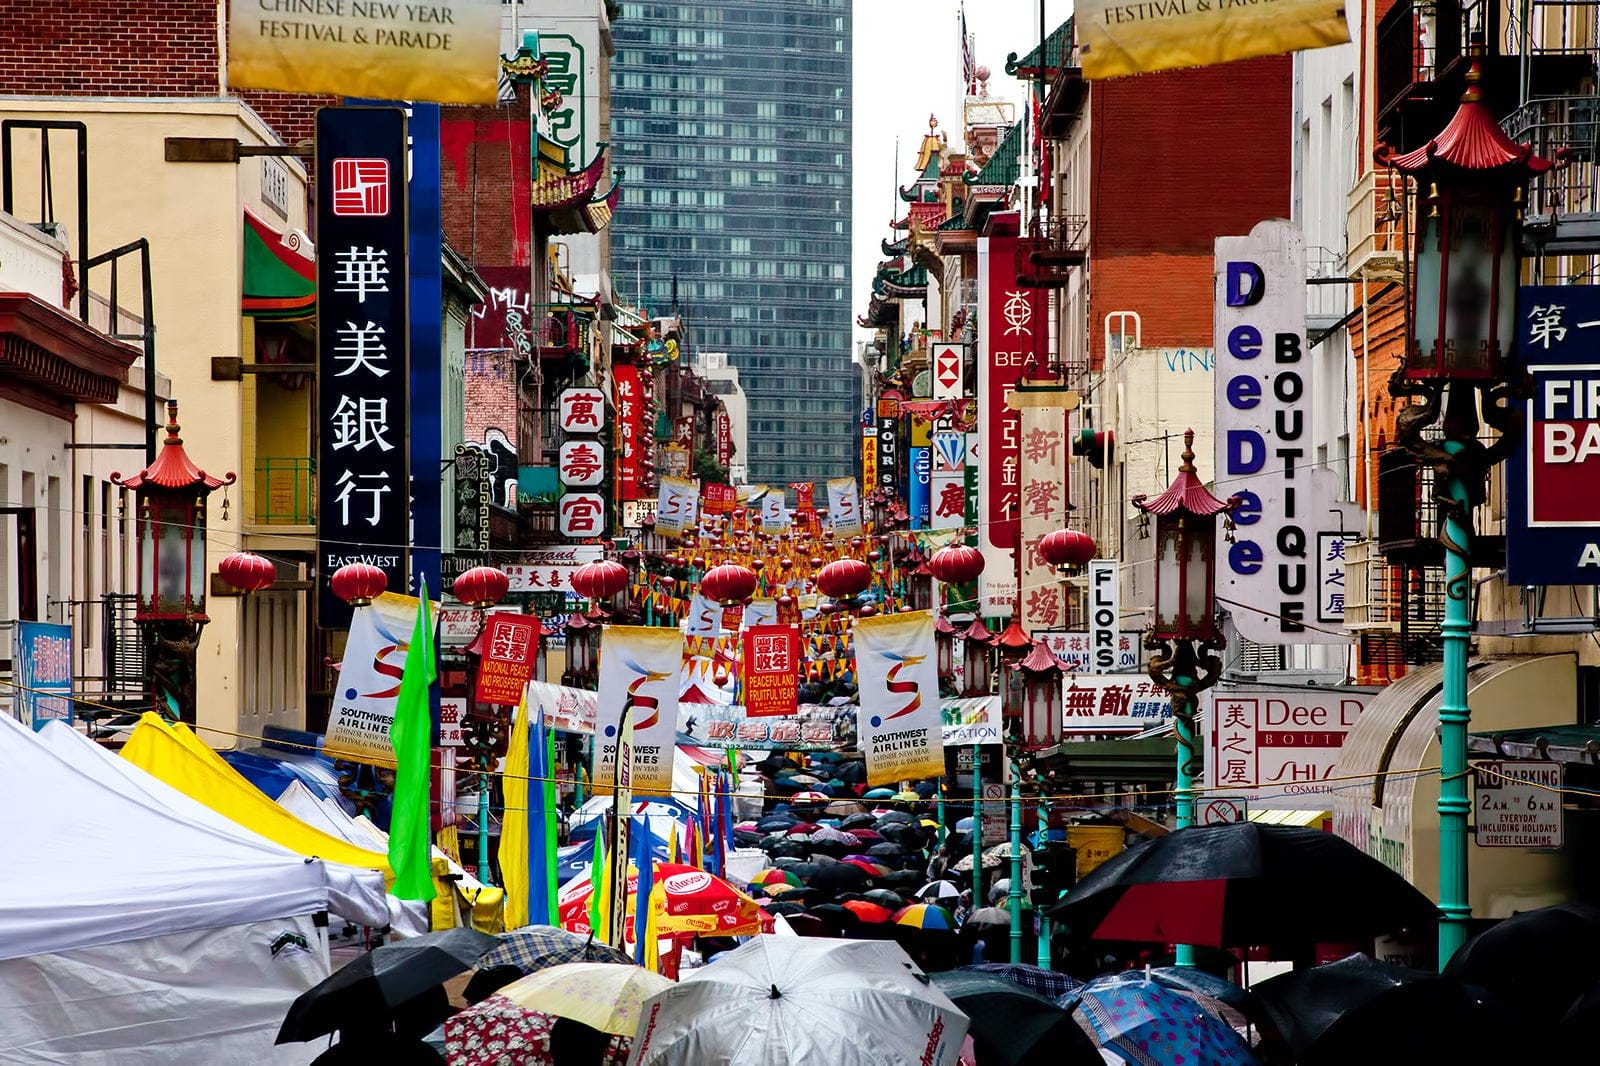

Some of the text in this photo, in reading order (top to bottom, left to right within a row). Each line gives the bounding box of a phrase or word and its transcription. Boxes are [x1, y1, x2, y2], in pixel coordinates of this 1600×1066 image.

[260, 0, 454, 24] CHINESE NEW YEAR
[1105, 0, 1192, 24] FESTIVAL
[260, 20, 452, 50] FESTIVAL & PARADE
[995, 351, 1038, 367] BEA
[331, 247, 395, 526] 華美銀行
[882, 419, 894, 465] FOUR
[562, 393, 603, 532] 萬壽宮
[1273, 333, 1306, 633] BOUTIQUE
[482, 660, 529, 677] NATIONAL PEACE
[480, 674, 525, 690] AND PROSPERIT
[749, 674, 794, 688] PEACEFUL AND
[749, 687, 795, 701] FRUITFUL YEAR
[1066, 684, 1133, 717] 無敵
[340, 707, 394, 725] SOUTHWES
[1265, 699, 1327, 726] Dee
[338, 717, 388, 734] AIRLINE
[942, 727, 997, 740] STATION
[872, 728, 928, 744] SOUTHWEST
[1221, 704, 1252, 784] 美之屋
[873, 738, 927, 753] AIRLINES
[1478, 765, 1558, 786] NO PARKING
[1482, 794, 1491, 811] 2
[1493, 802, 1510, 811] A.M.
[1527, 795, 1536, 811] 6
[1540, 802, 1556, 811] A.M.
[1500, 814, 1537, 823] EVERYDAY
[1480, 823, 1557, 833] INCLUDING HOLIDAYS
[1486, 835, 1551, 845] STREET CLEANING
